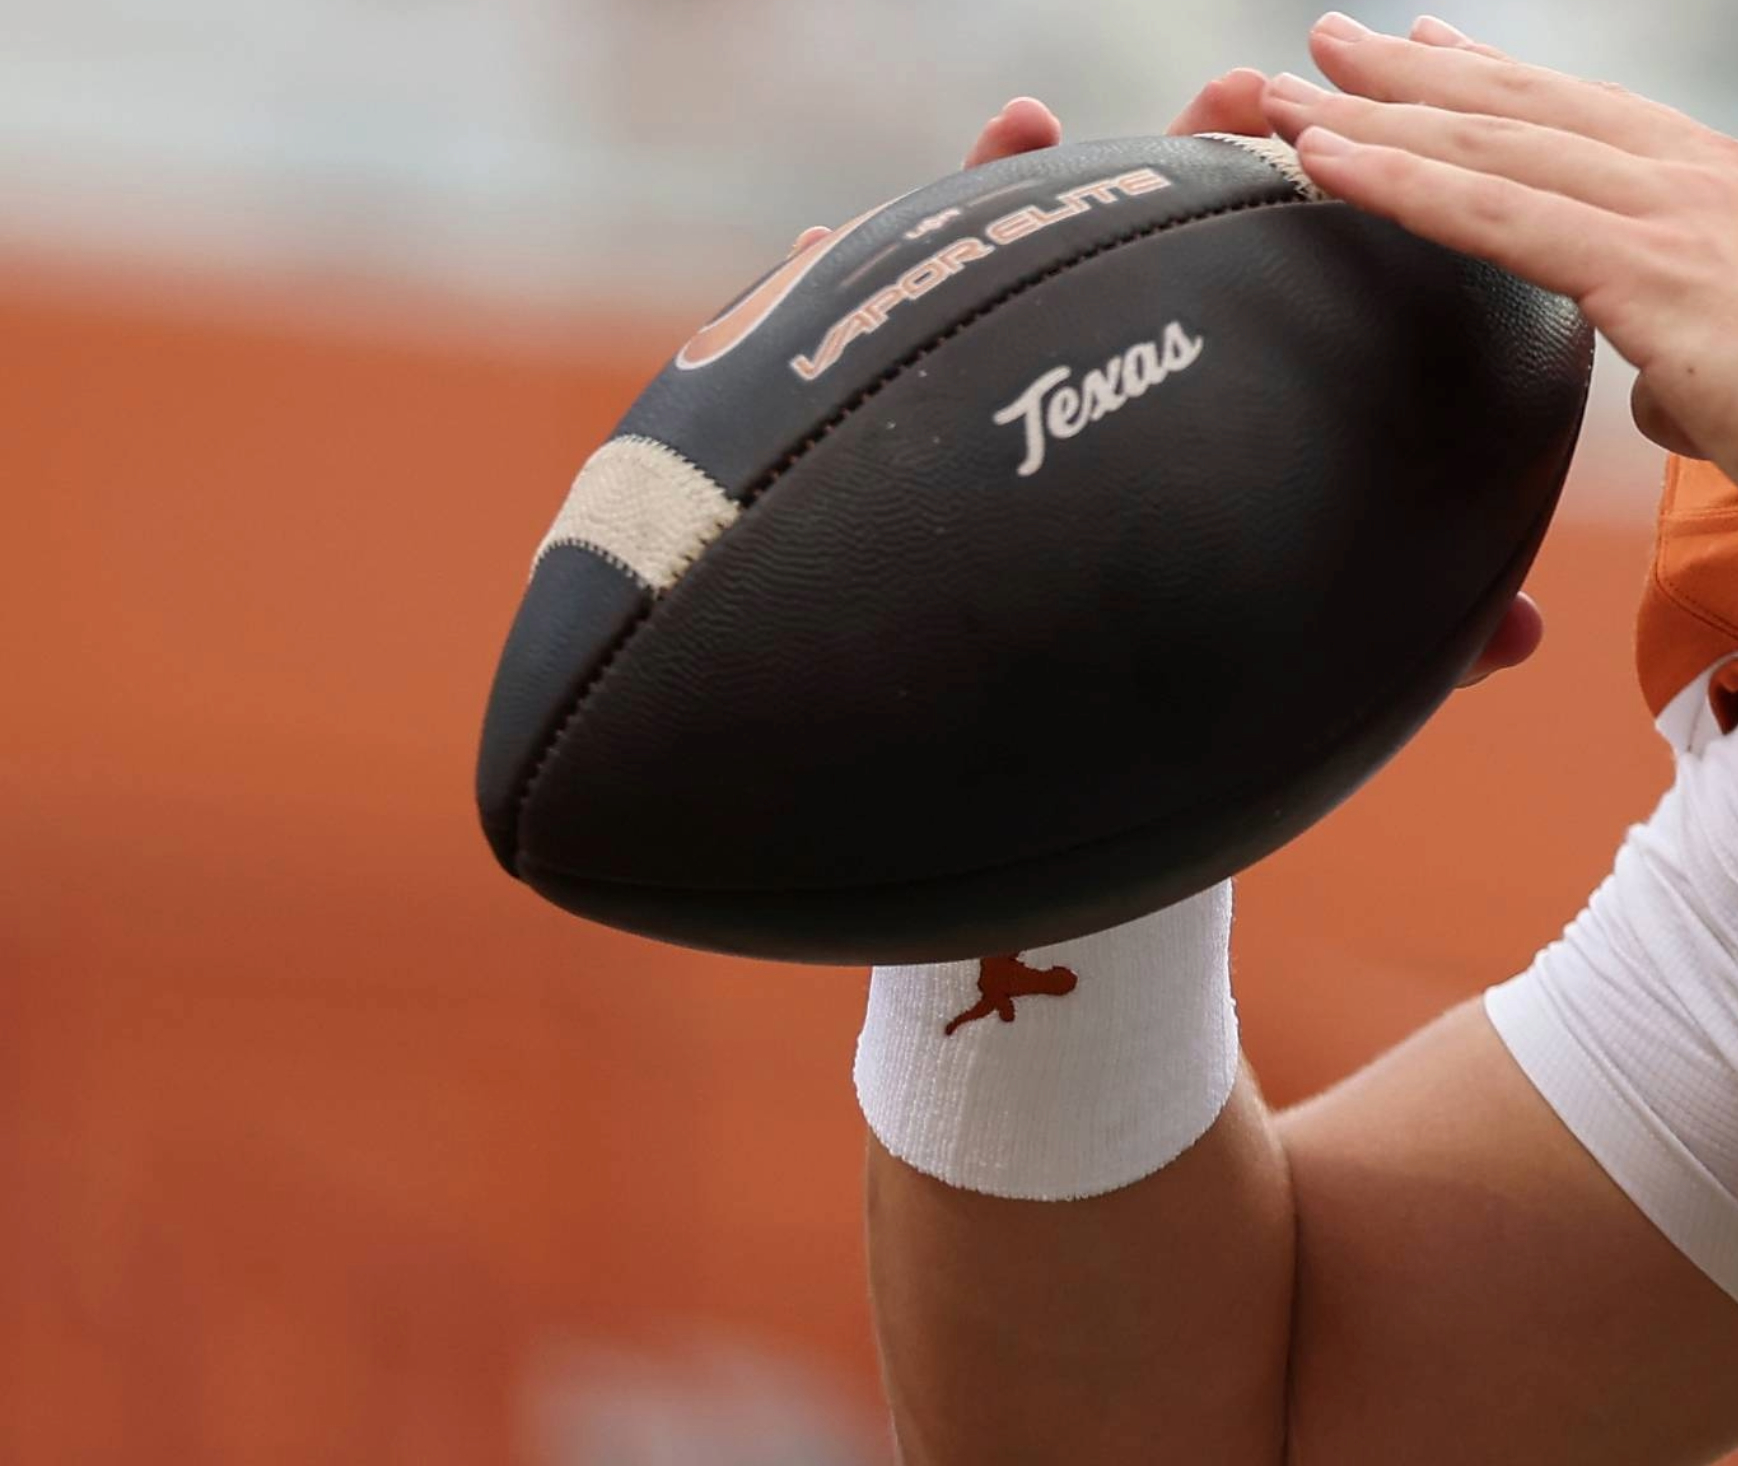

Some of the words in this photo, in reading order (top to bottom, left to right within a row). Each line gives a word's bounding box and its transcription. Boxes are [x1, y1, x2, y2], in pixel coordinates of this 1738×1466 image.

[790, 237, 996, 382] VAPOR
[985, 167, 1173, 245] ELITE
[993, 320, 1204, 477] Texas
